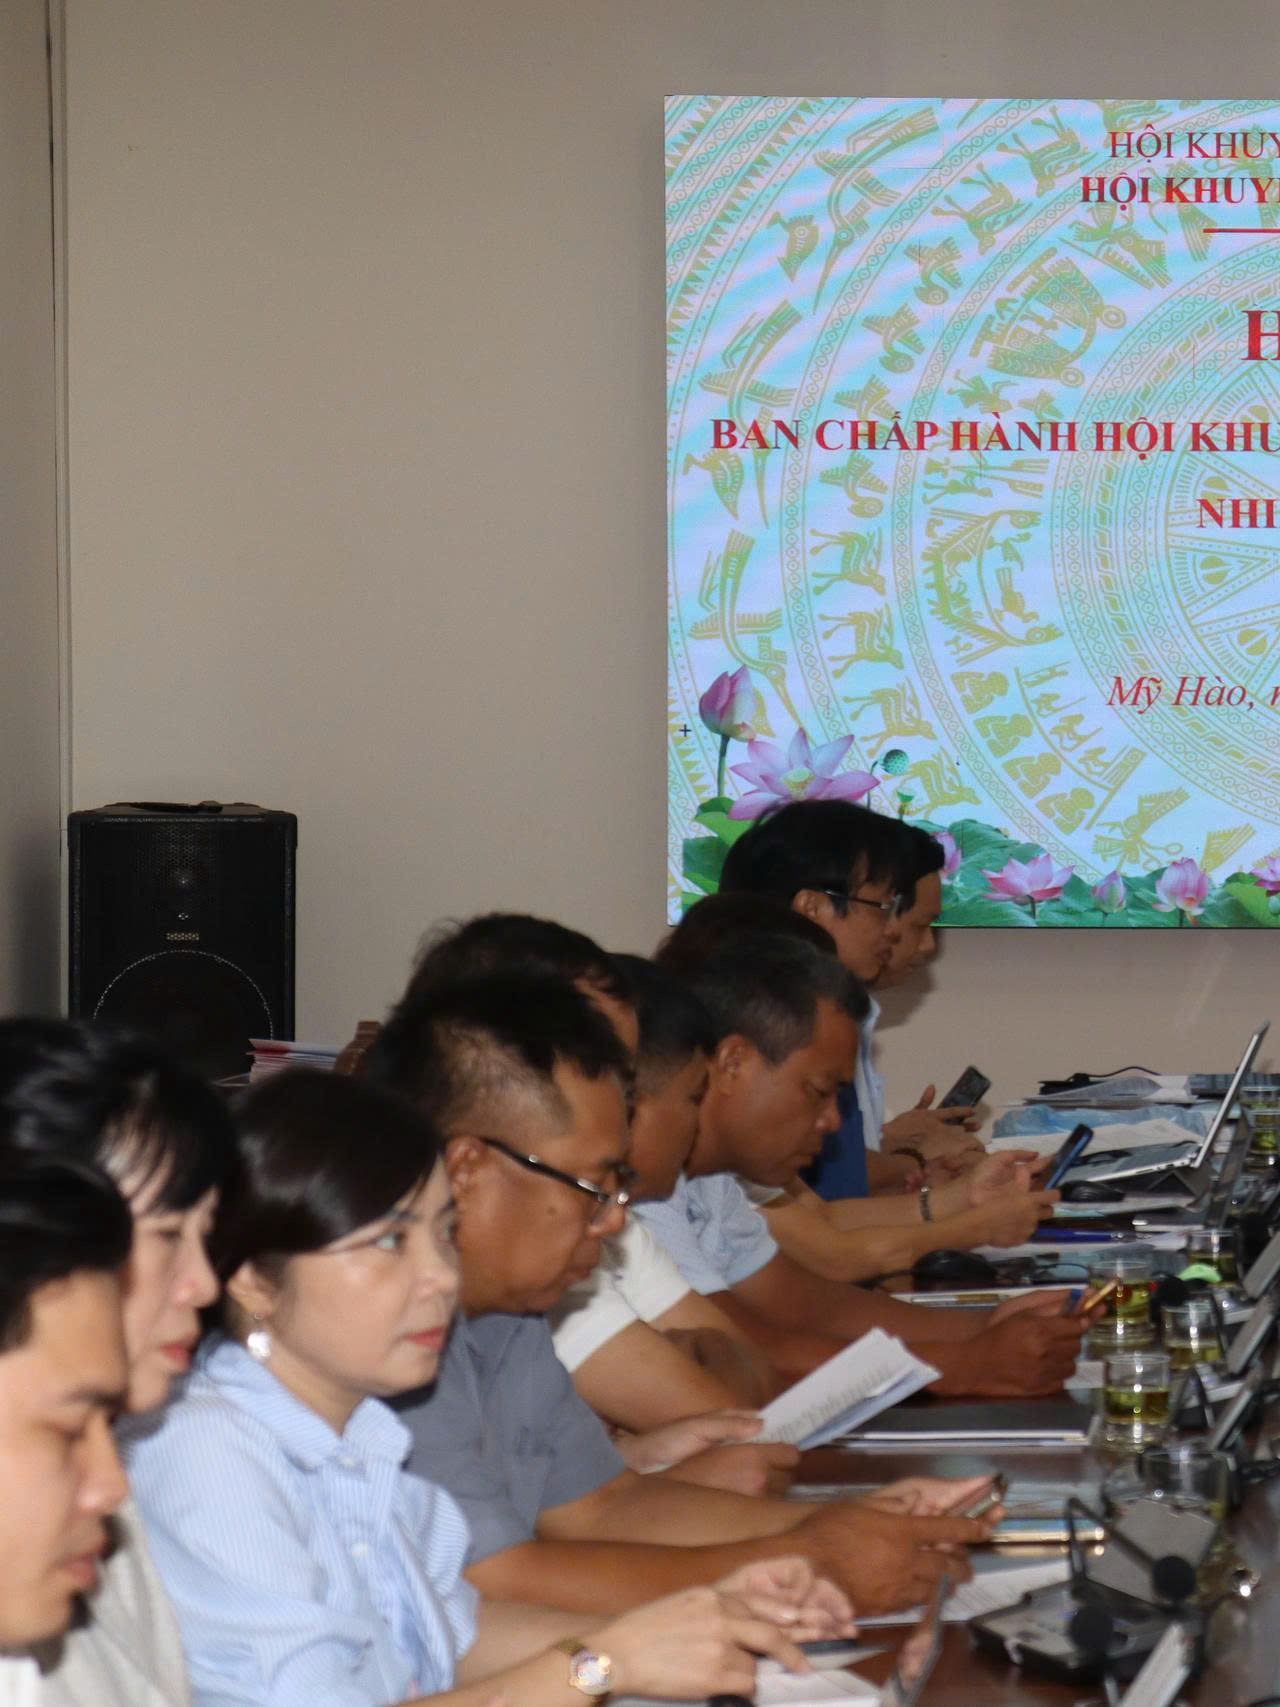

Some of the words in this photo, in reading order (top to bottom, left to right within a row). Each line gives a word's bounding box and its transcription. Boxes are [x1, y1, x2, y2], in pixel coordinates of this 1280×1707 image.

[1108, 123, 1173, 163] HỘI
[1080, 172, 1152, 211] HỘI
[711, 418, 801, 451] BAN
[814, 412, 939, 452] CHẤP
[949, 412, 1079, 452] HÀNH
[1092, 414, 1176, 461] HỘI
[1106, 675, 1165, 716] Mỹ
[1170, 676, 1254, 714] Hào,
